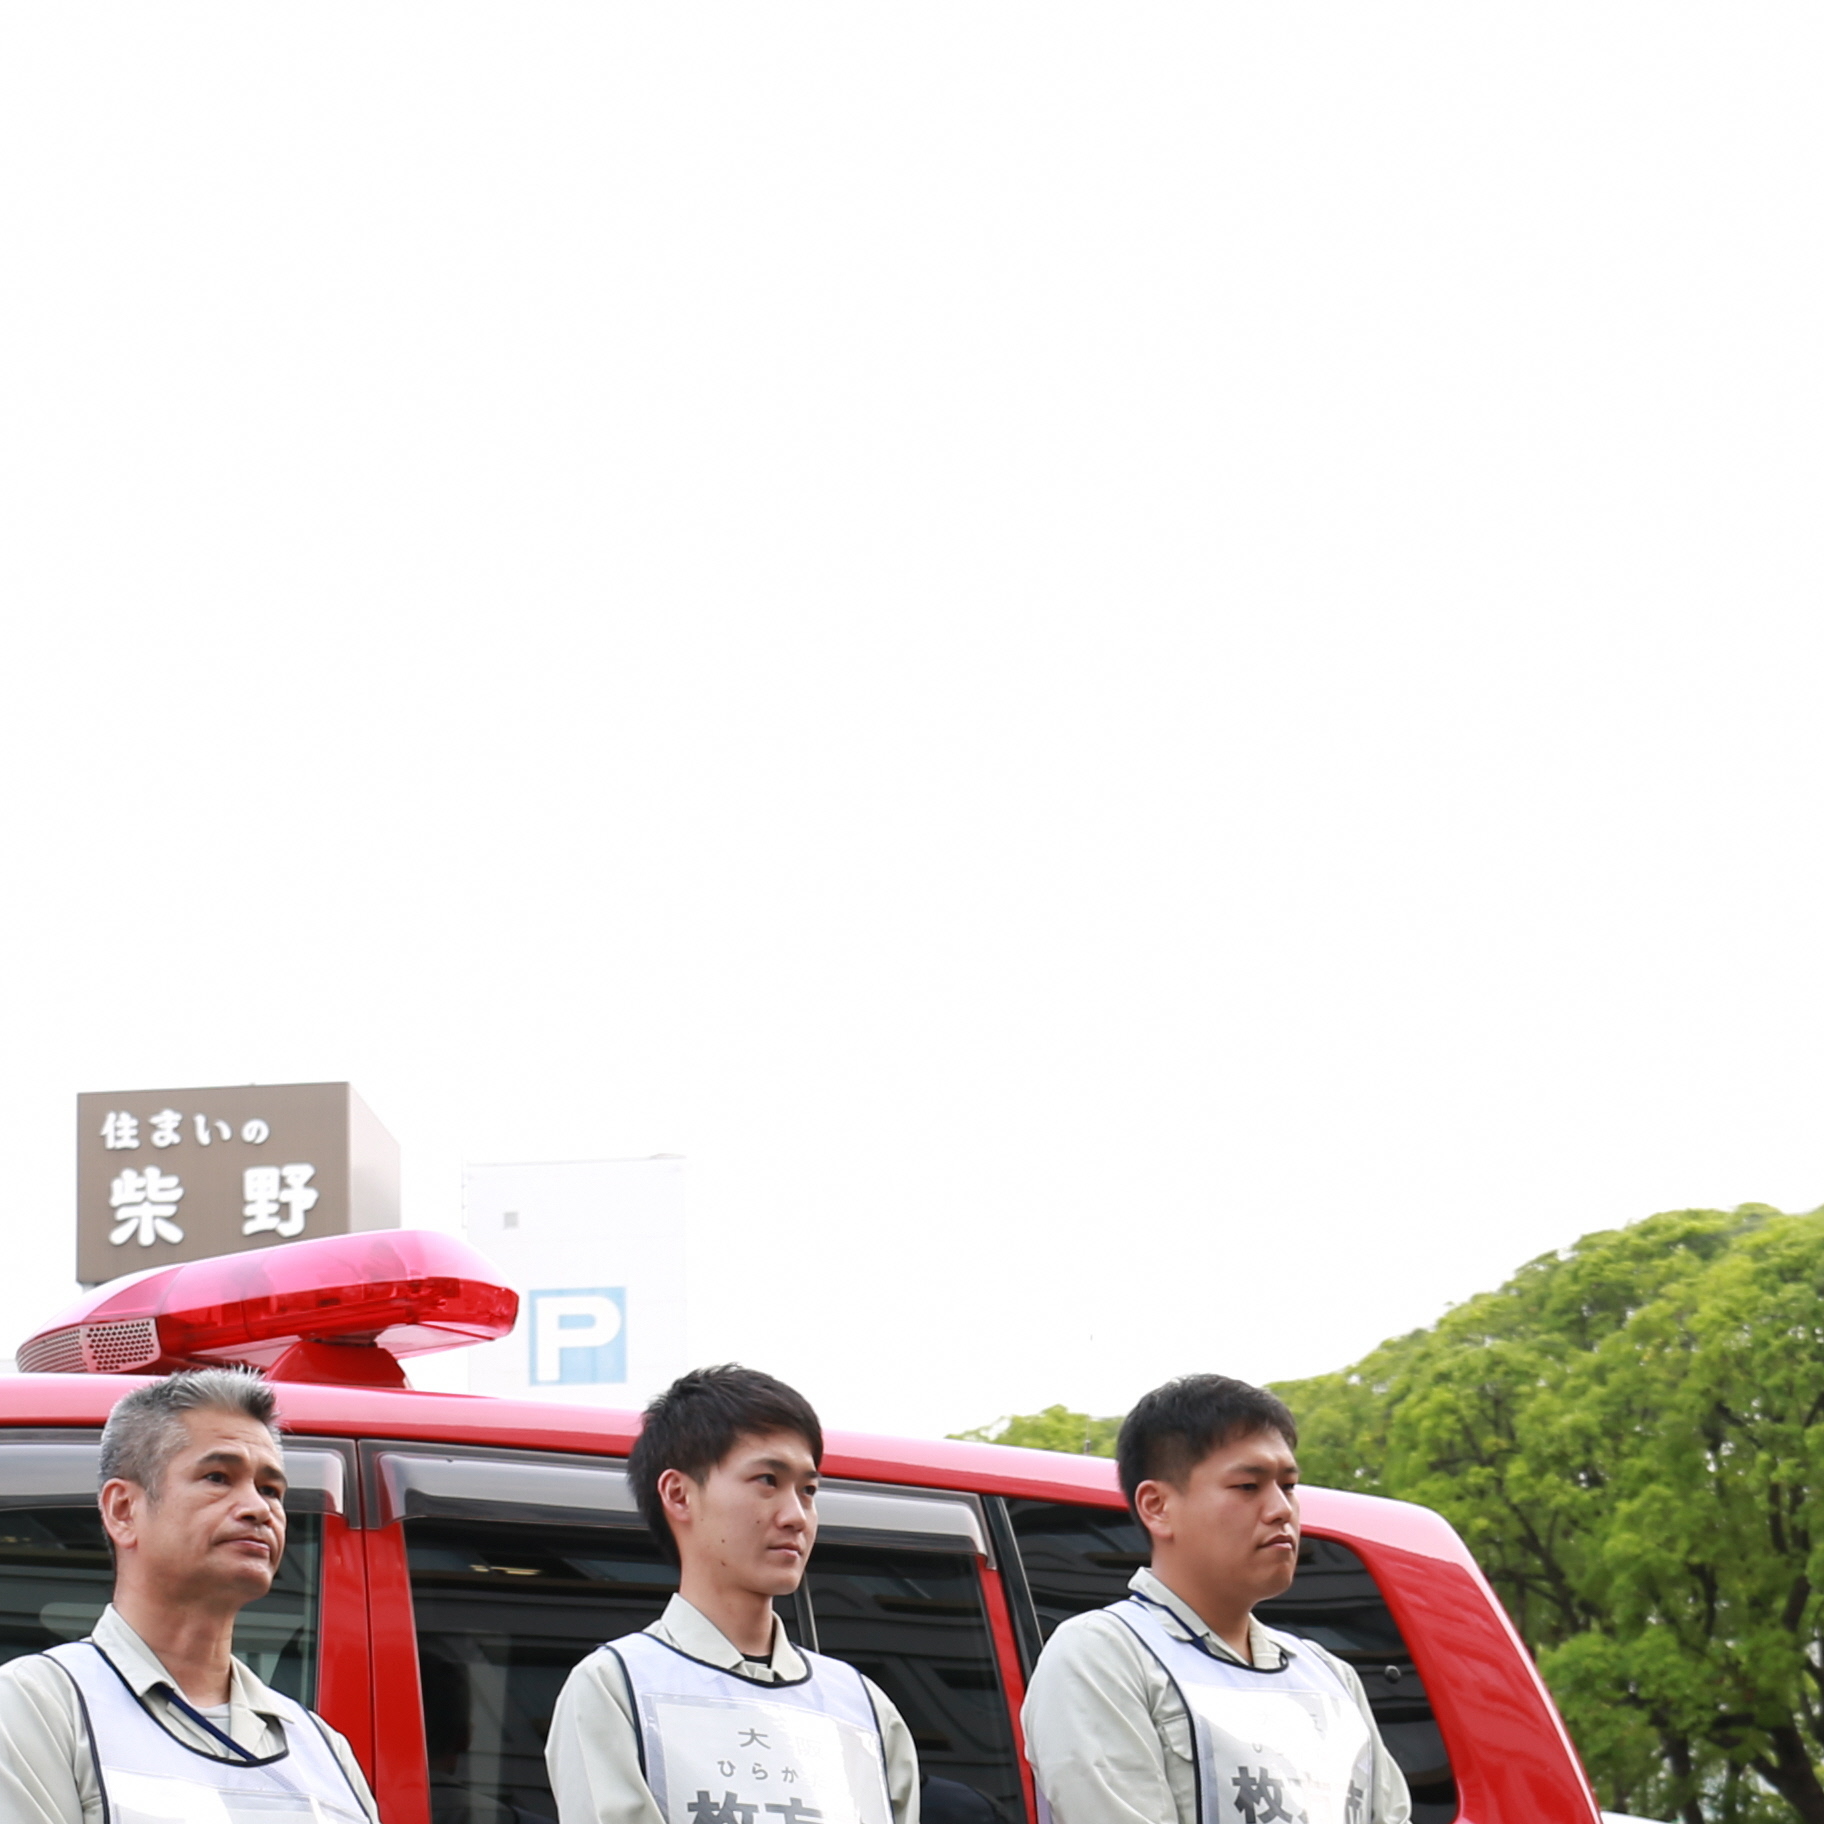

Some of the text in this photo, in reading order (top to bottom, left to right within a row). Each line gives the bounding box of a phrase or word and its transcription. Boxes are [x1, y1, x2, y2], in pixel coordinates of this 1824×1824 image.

[101, 1109, 270, 1149] 住まいの
[109, 1163, 319, 1247] 柴野
[537, 1297, 621, 1380] P
